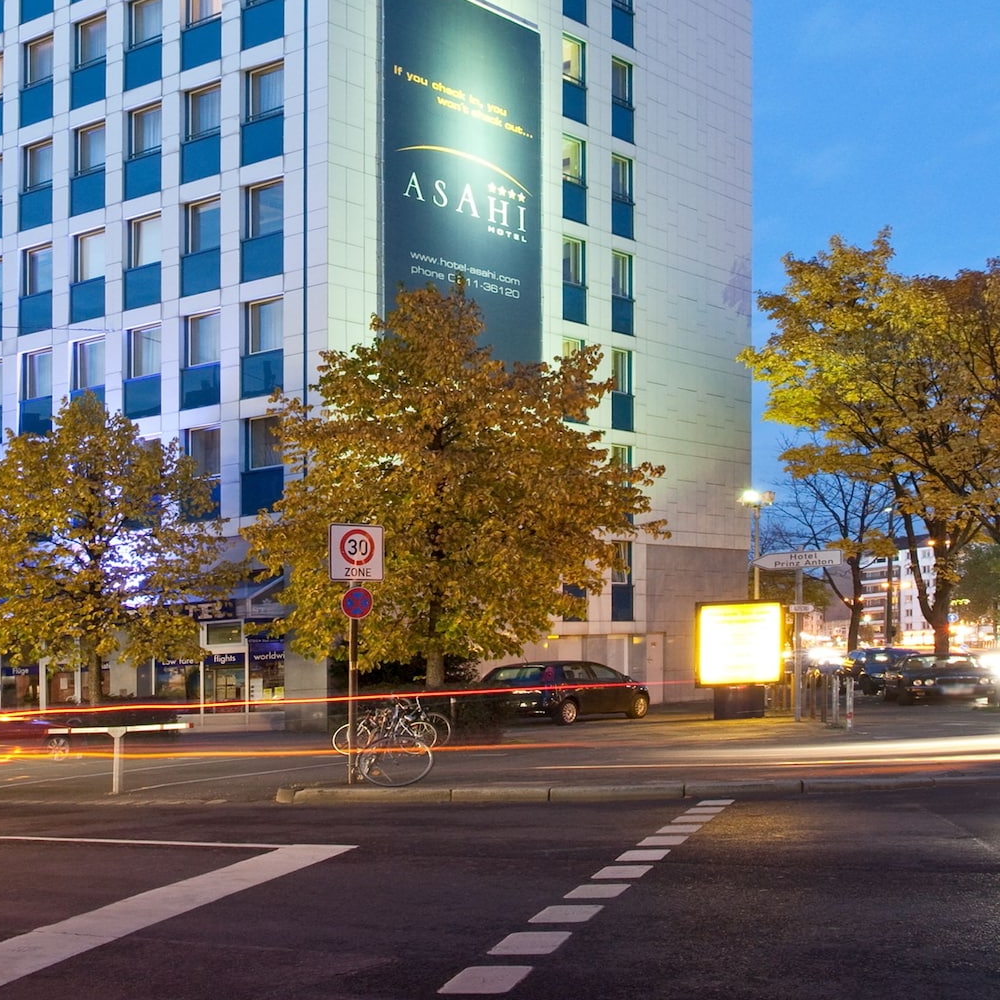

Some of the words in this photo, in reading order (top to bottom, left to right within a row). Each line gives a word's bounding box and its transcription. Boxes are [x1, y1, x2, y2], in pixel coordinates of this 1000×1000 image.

[393, 65, 403, 76] If
[406, 71, 428, 87] you
[431, 81, 466, 101] check
[487, 102, 508, 117] you
[437, 96, 469, 115] won't
[471, 108, 502, 128] check
[504, 121, 534, 139] out...
[403, 171, 527, 233] ASAHI
[487, 225, 528, 243] HOTEL
[410, 250, 521, 286] www.hotel-asahi.com
[410, 265, 445, 281] phone
[447, 272, 520, 299] 011-36120
[347, 538, 368, 556] 30
[774, 560, 800, 568] Prinz
[804, 558, 834, 566] Anton
[789, 552, 818, 561] Hotel
[344, 567, 372, 577] ZONE
[213, 654, 236, 665] flights
